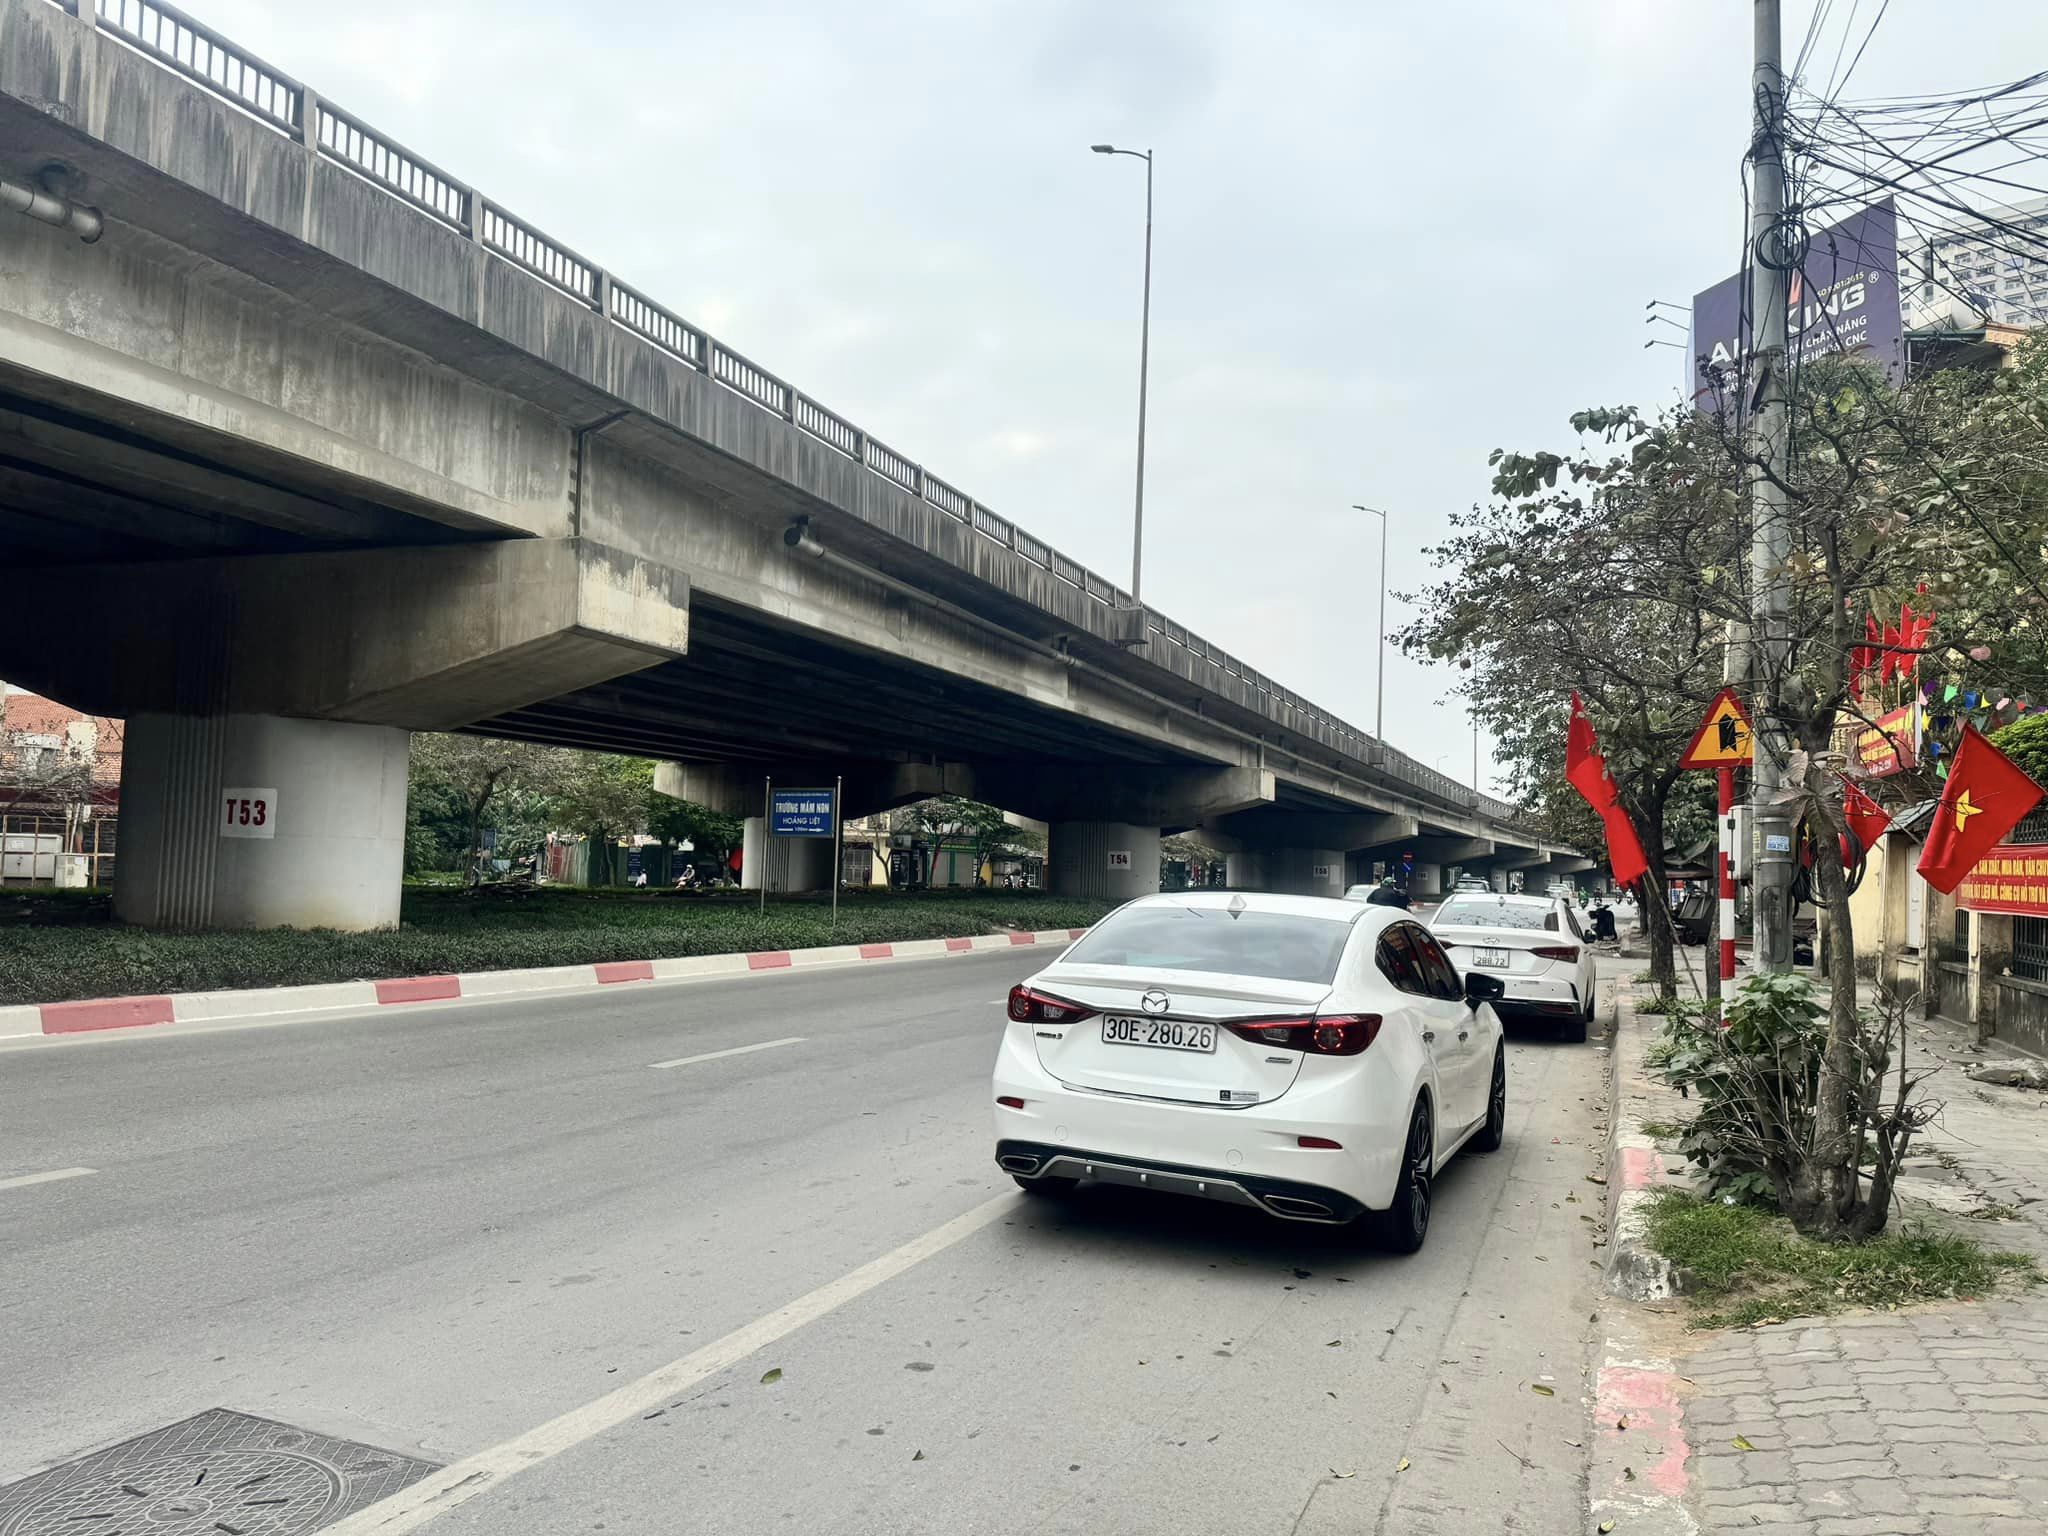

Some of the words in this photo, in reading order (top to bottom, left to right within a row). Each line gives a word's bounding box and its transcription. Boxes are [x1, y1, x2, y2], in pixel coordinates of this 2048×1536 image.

[1845, 330, 1868, 347] CNC
[227, 799, 266, 826] T53
[1106, 1018, 1211, 1048] 30E-280.26
